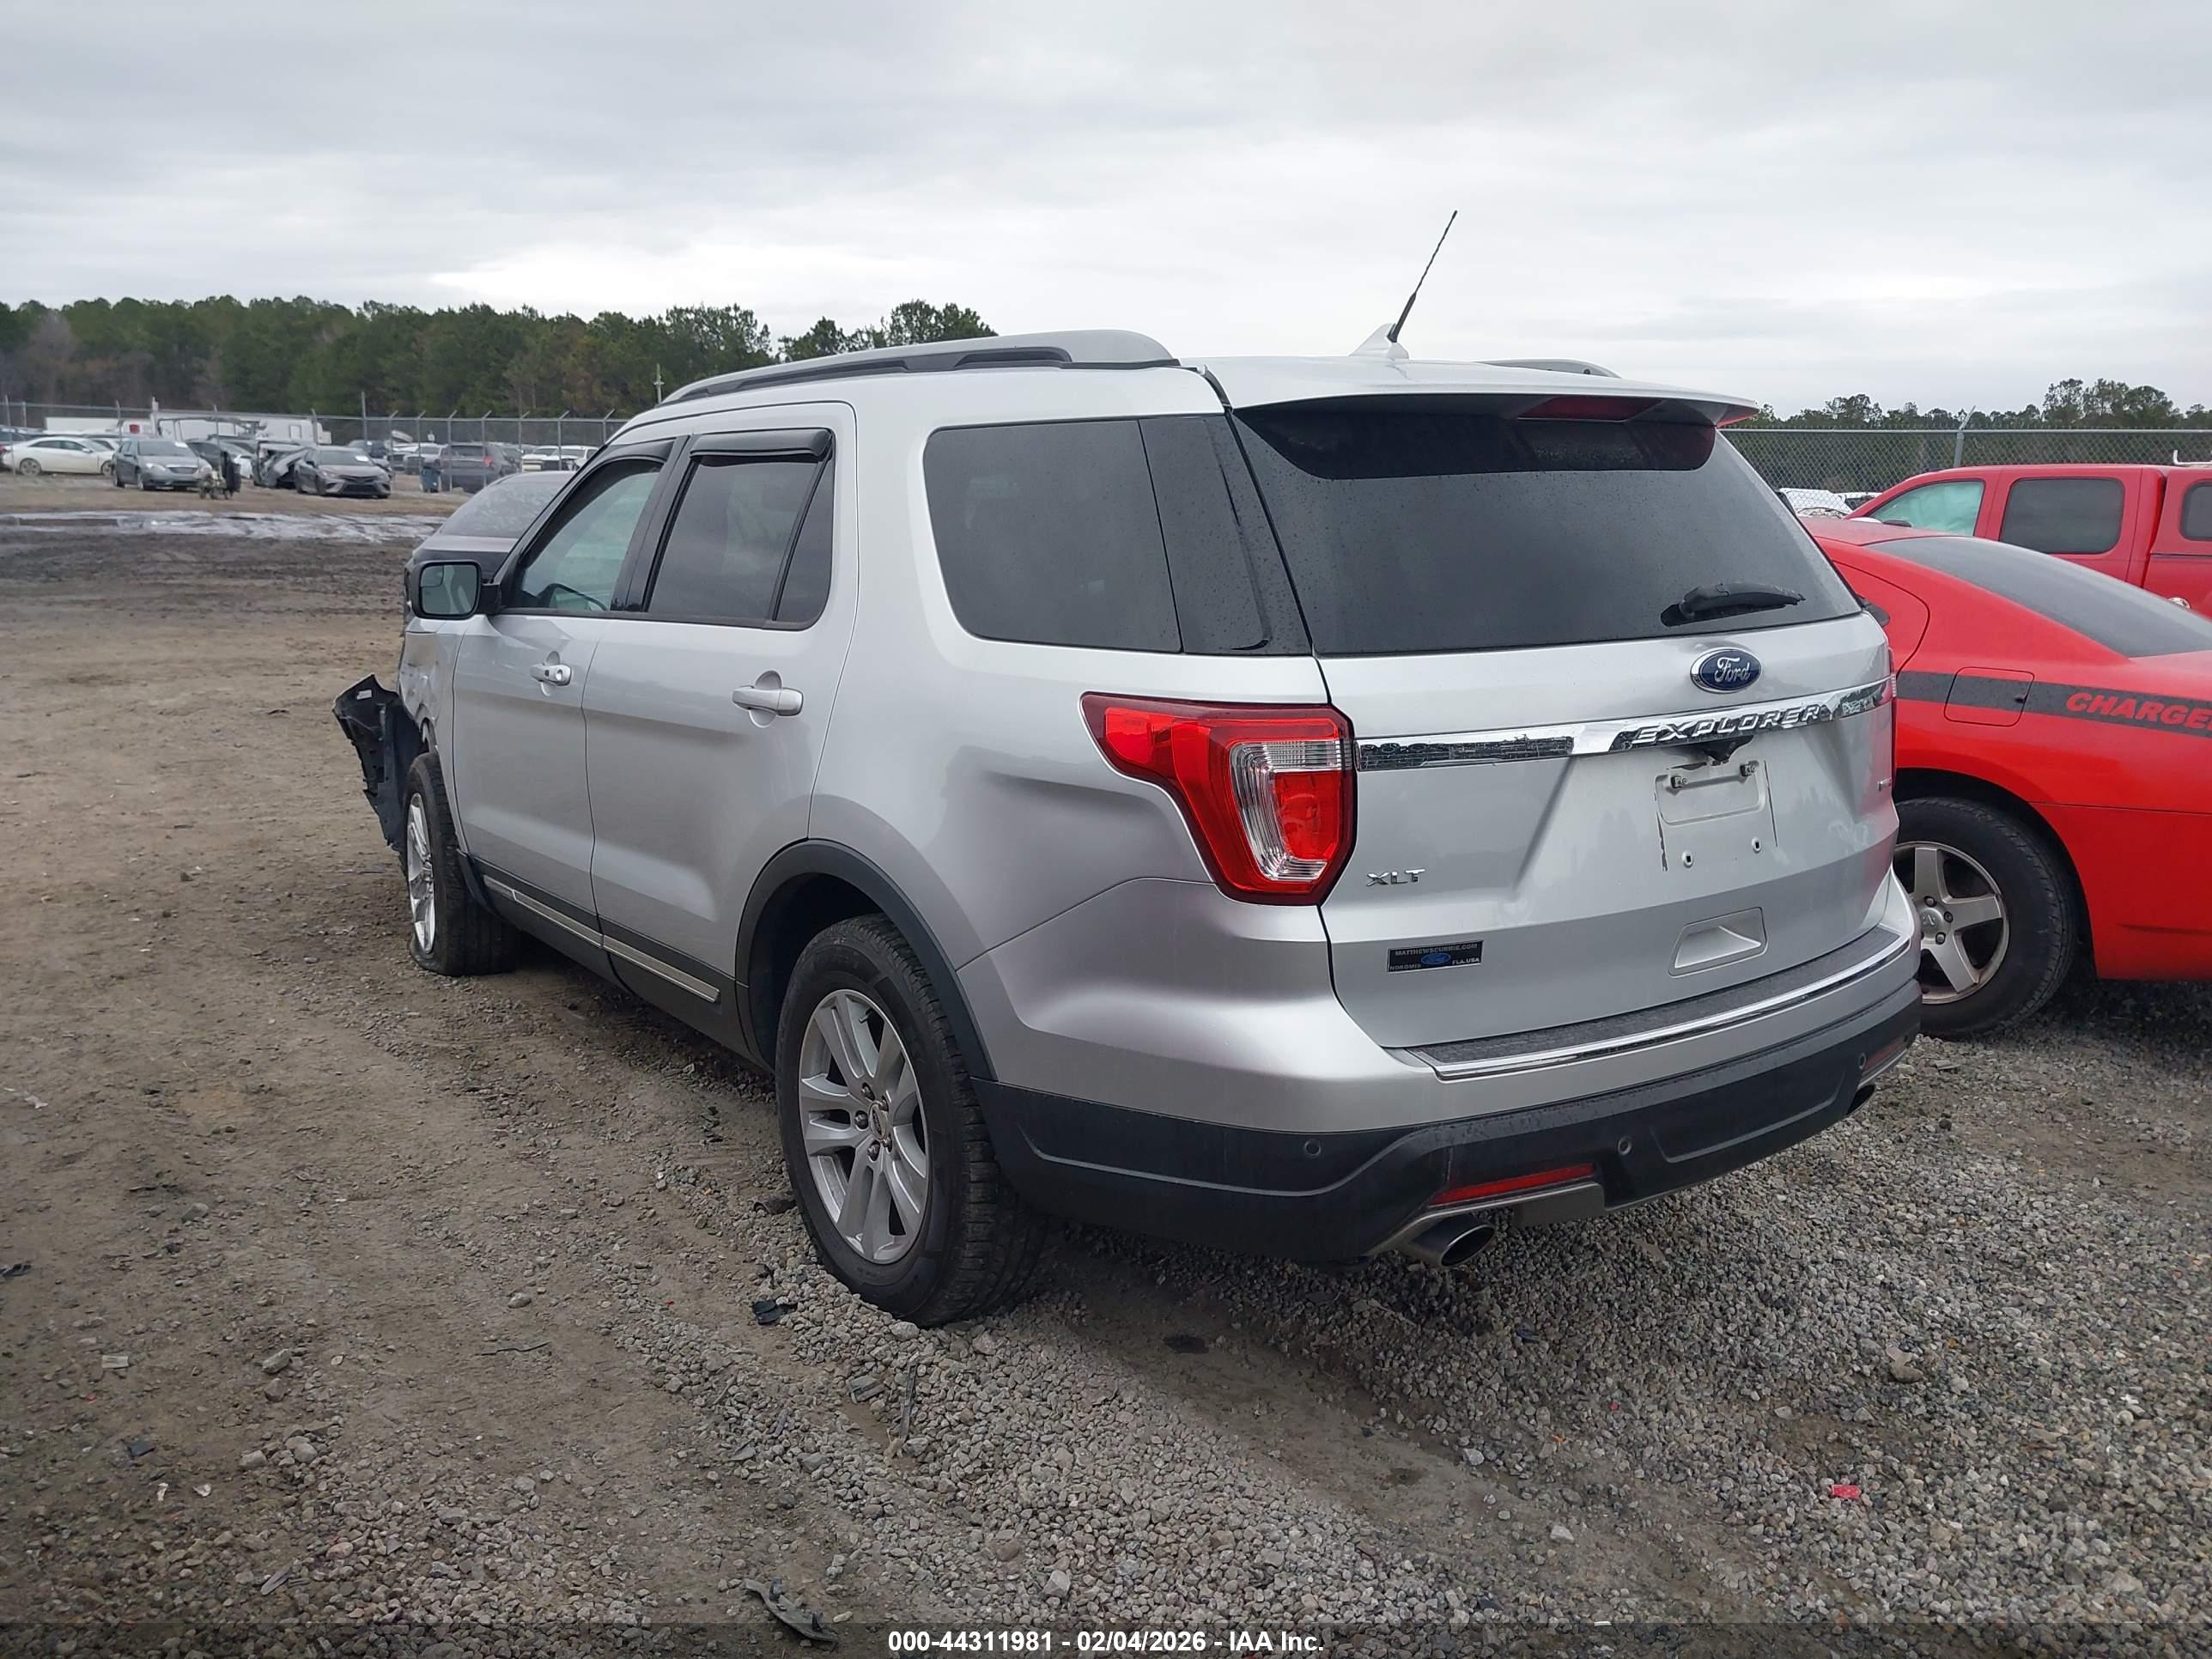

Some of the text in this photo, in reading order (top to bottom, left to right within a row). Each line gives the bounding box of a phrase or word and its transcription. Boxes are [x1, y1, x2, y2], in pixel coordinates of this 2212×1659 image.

[1714, 656, 1751, 683] Ford
[1632, 703, 1822, 745] EXPLORER
[1366, 868, 1425, 887] XLT
